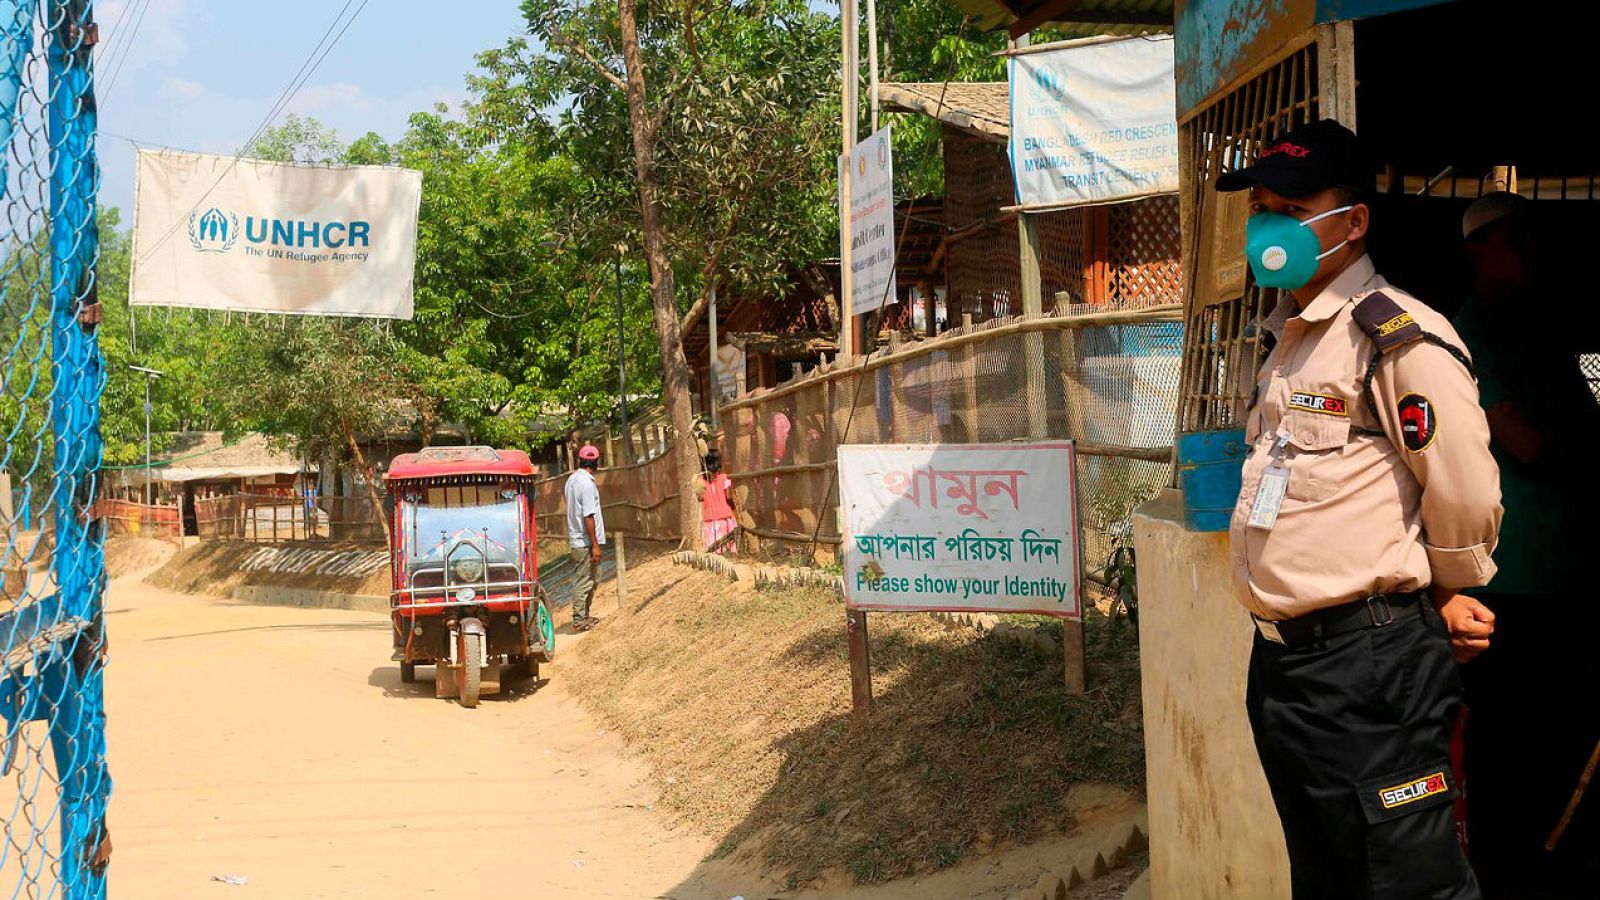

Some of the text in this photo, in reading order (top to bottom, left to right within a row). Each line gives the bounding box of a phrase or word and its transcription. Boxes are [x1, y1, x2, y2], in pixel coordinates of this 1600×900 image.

[1024, 132, 1097, 150] BANGLADESH
[1101, 129, 1123, 144] RED
[1024, 153, 1076, 171] MYANMAR
[1130, 145, 1169, 162] RELIEF
[1063, 171, 1105, 188] TRANSIT
[245, 215, 370, 249] UNHCR
[245, 246, 369, 264] The UN Refugee Agency
[1291, 393, 1344, 412] SECUREX
[883, 465, 1028, 520] থামুন
[854, 528, 1062, 564] আপনার পরিচয় দিন
[914, 574, 958, 593] show
[962, 576, 1000, 599] your
[1005, 574, 1067, 603] Identity
[1384, 776, 1443, 804] SECUREX
